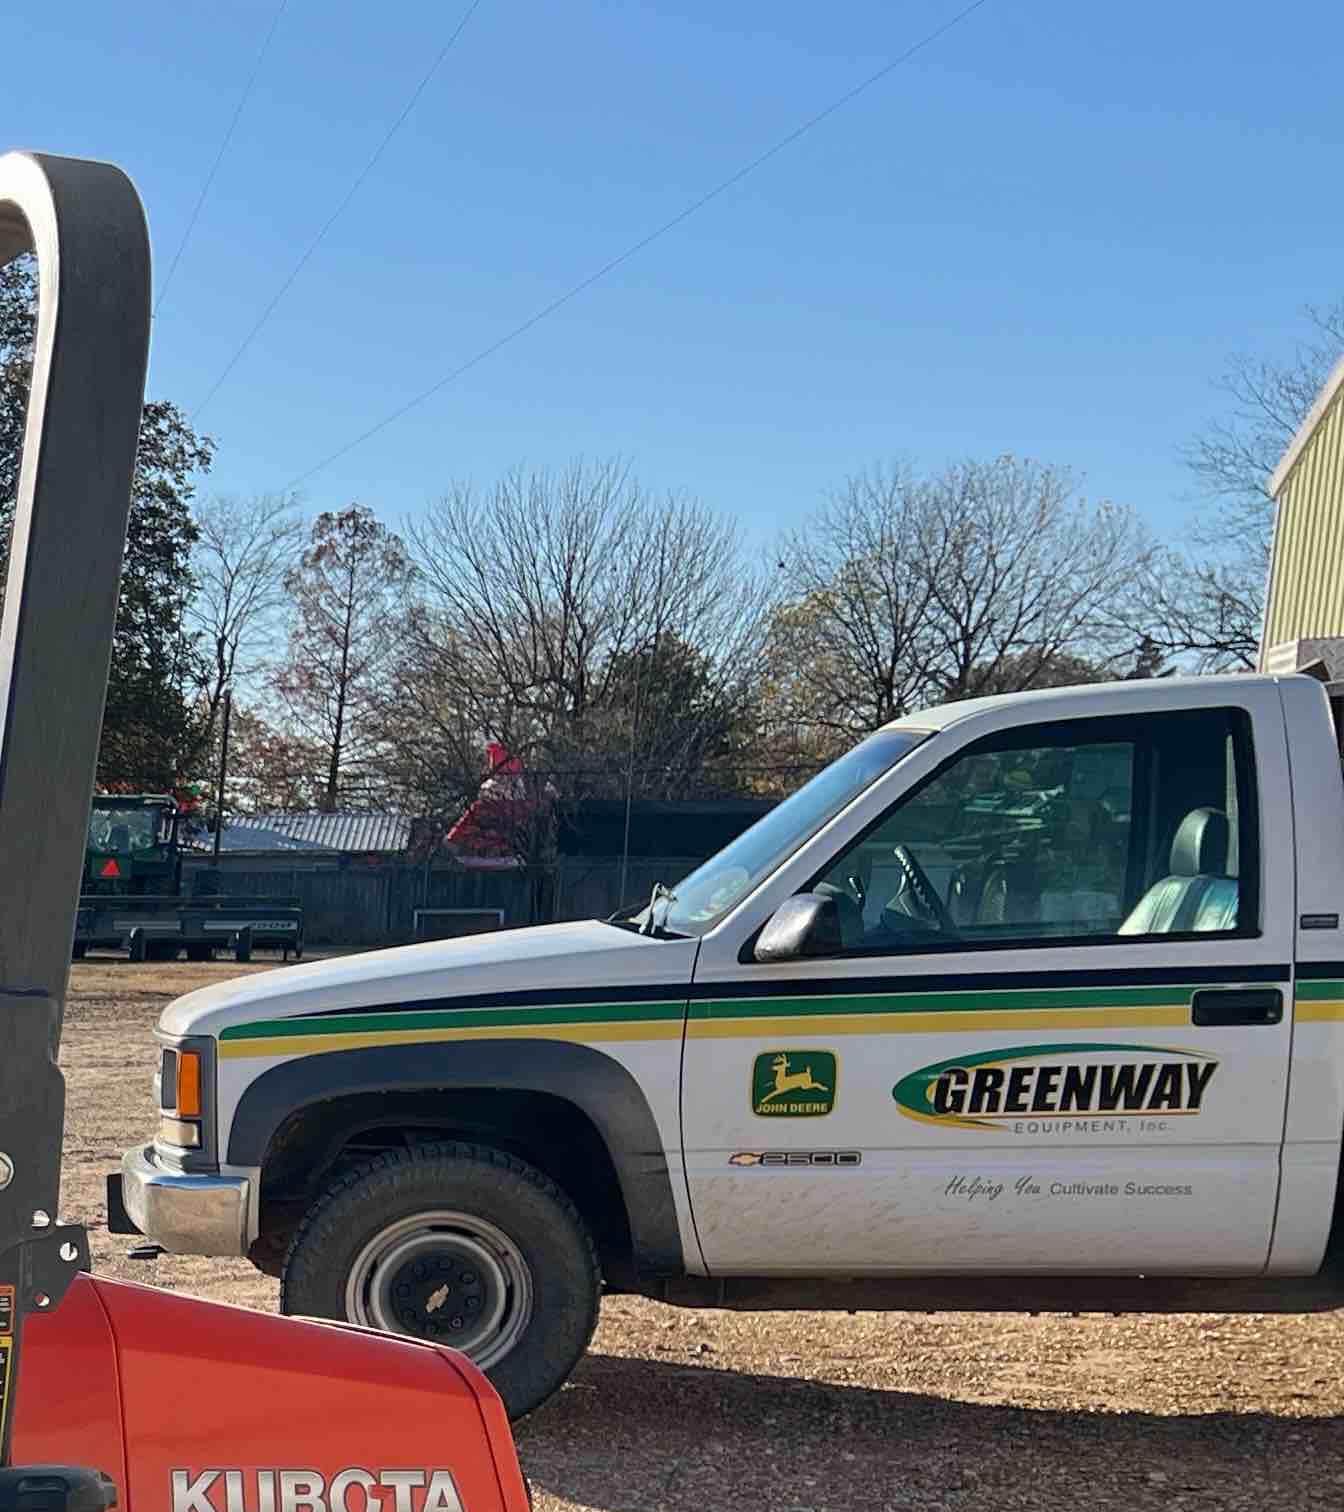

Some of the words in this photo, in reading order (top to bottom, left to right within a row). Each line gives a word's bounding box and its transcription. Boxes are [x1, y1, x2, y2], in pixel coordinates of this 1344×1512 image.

[934, 1061, 1219, 1115] GREENWAY
[756, 1103, 787, 1113] JOHN
[790, 1103, 828, 1113] DEERE
[762, 1152, 861, 1166] 2500
[944, 1175, 1005, 1200] Helping
[1014, 1175, 1041, 1195] You
[1049, 1181, 1119, 1196] Cultivate
[1124, 1182, 1193, 1196] Success
